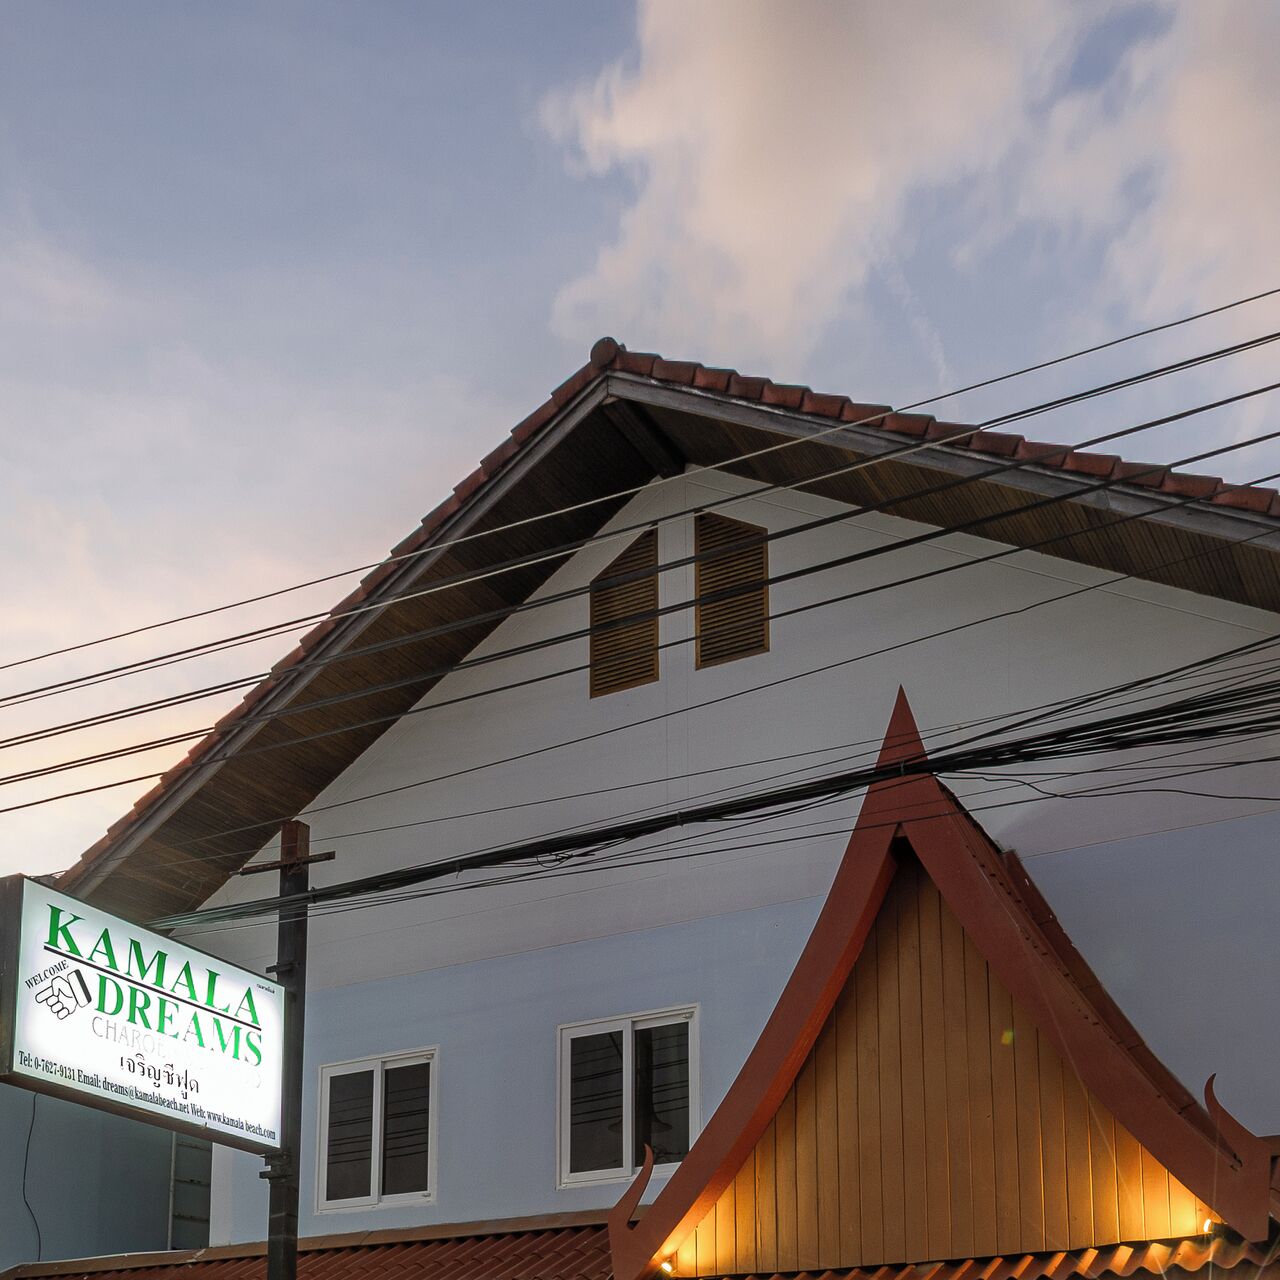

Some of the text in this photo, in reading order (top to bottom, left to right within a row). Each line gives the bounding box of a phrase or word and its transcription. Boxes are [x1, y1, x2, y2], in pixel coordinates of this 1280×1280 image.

[25, 960, 69, 989] WELCOME
[44, 903, 261, 1026] KAMALA
[95, 973, 262, 1067] DREAMS
[19, 1050, 33, 1068] Tel:
[34, 1056, 76, 1081] 0-7627-9131
[78, 1069, 101, 1088] Email:
